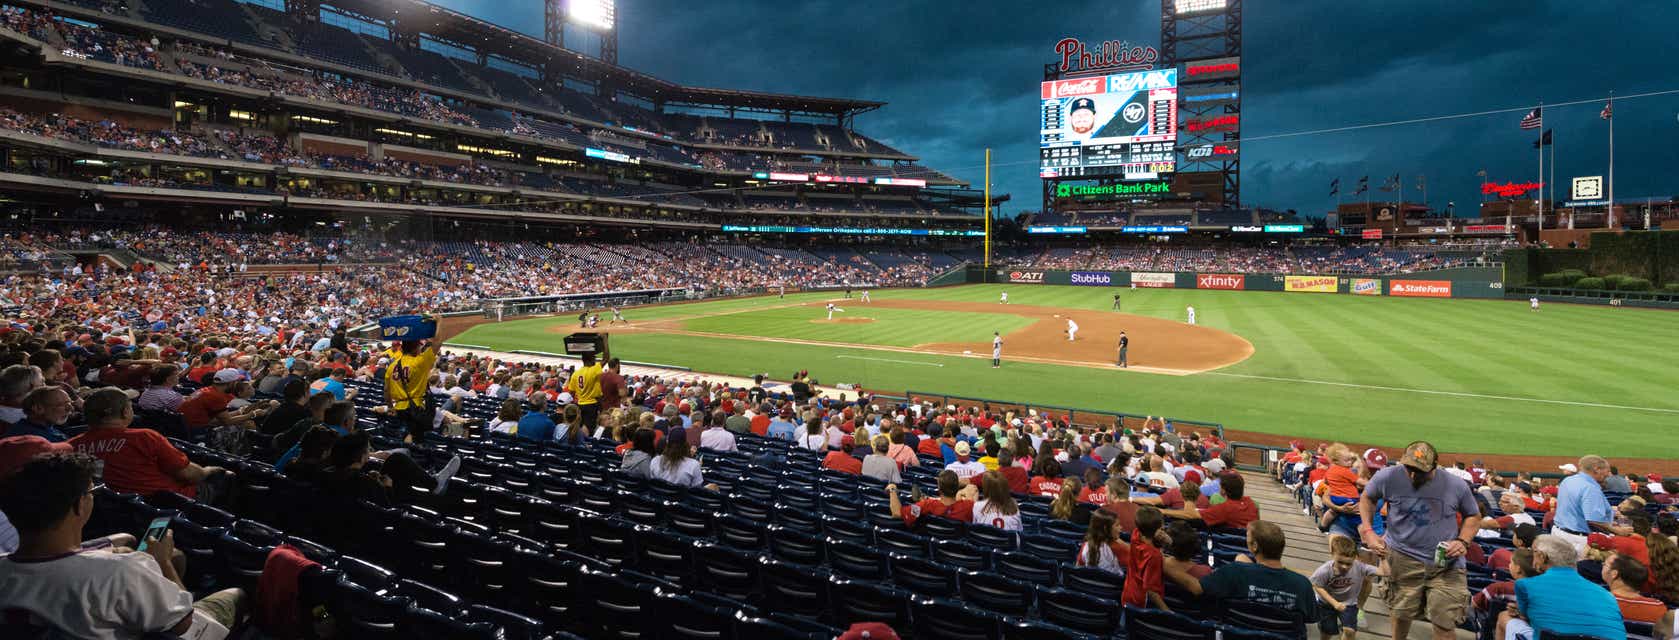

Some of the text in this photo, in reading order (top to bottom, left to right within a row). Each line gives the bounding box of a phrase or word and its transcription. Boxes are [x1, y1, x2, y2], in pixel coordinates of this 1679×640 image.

[1055, 38, 1158, 71] Phillies
[1110, 71, 1172, 92] RE/MAX
[1072, 182, 1169, 195] Citizens Bank Park
[1022, 272, 1044, 280] ATI
[1071, 273, 1110, 283] StubHub
[1200, 275, 1241, 289] xfinity
